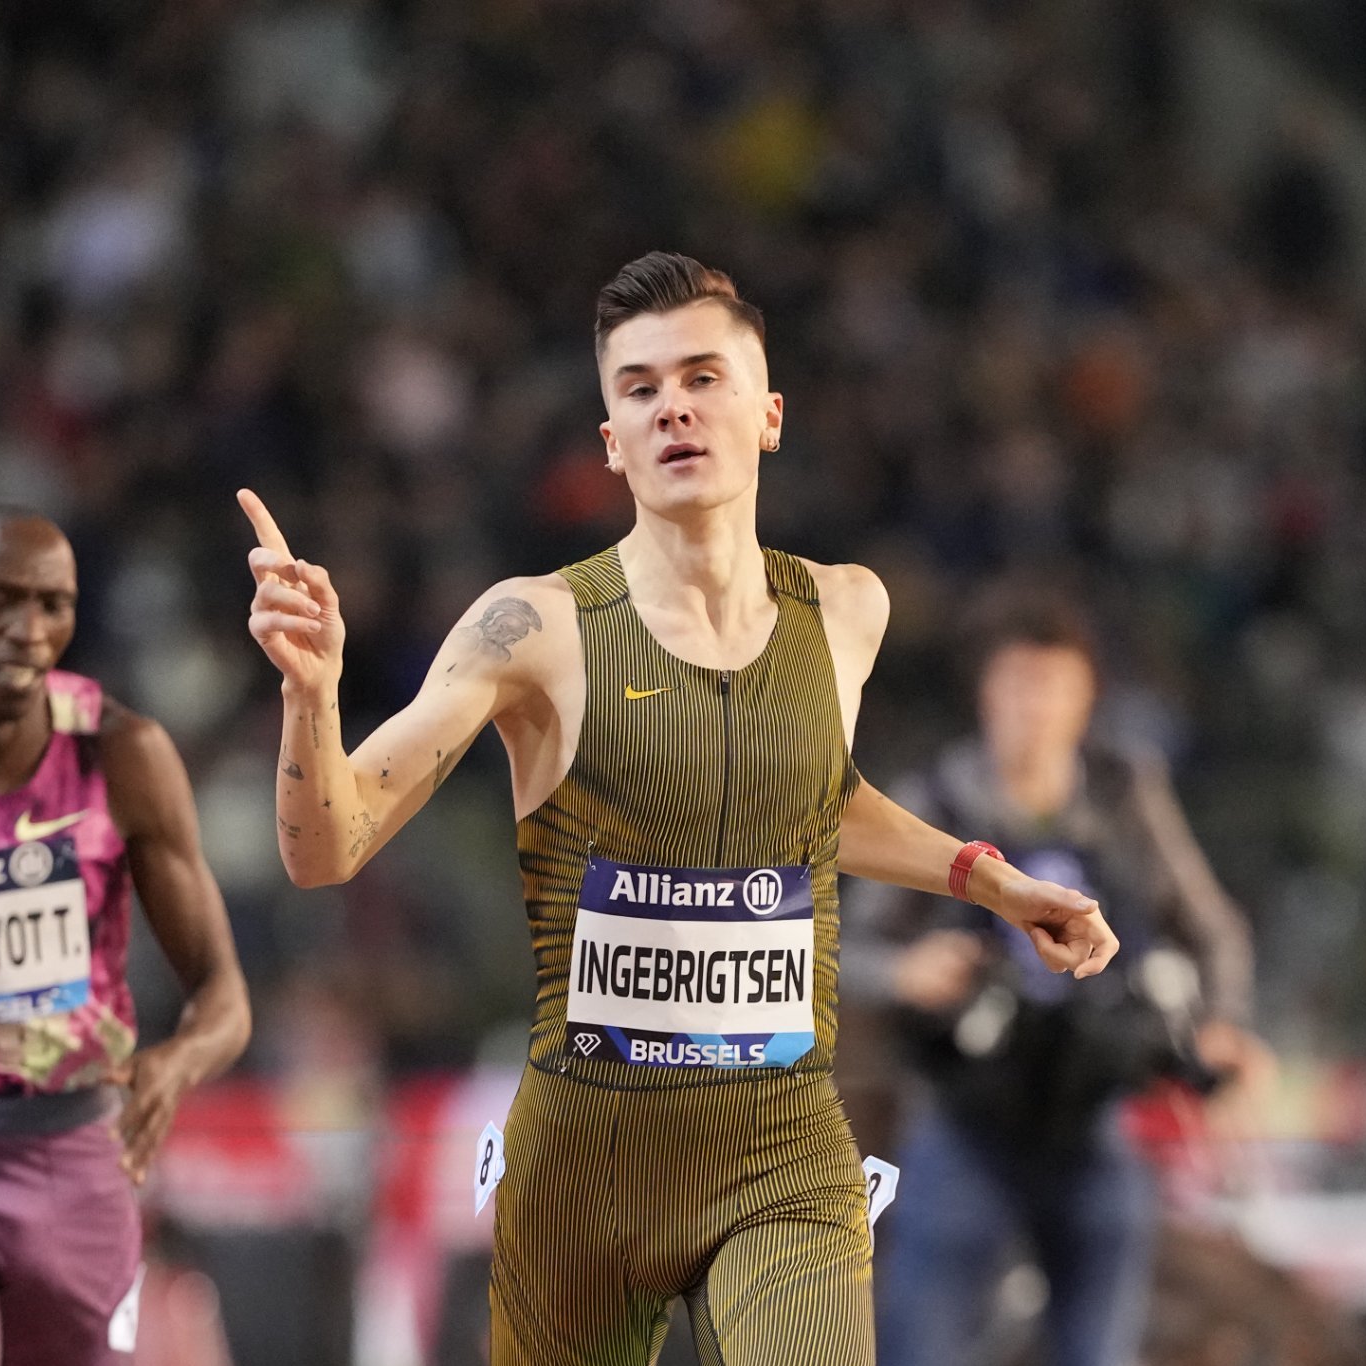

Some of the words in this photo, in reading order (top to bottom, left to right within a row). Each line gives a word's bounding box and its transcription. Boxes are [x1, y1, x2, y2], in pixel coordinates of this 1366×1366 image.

[609, 869, 734, 907] Allianz
[53, 906, 82, 960] T.
[577, 939, 806, 1003] INGEBRIGTSEN
[630, 1038, 766, 1066] BRUSSELS
[479, 1138, 494, 1186] 8
